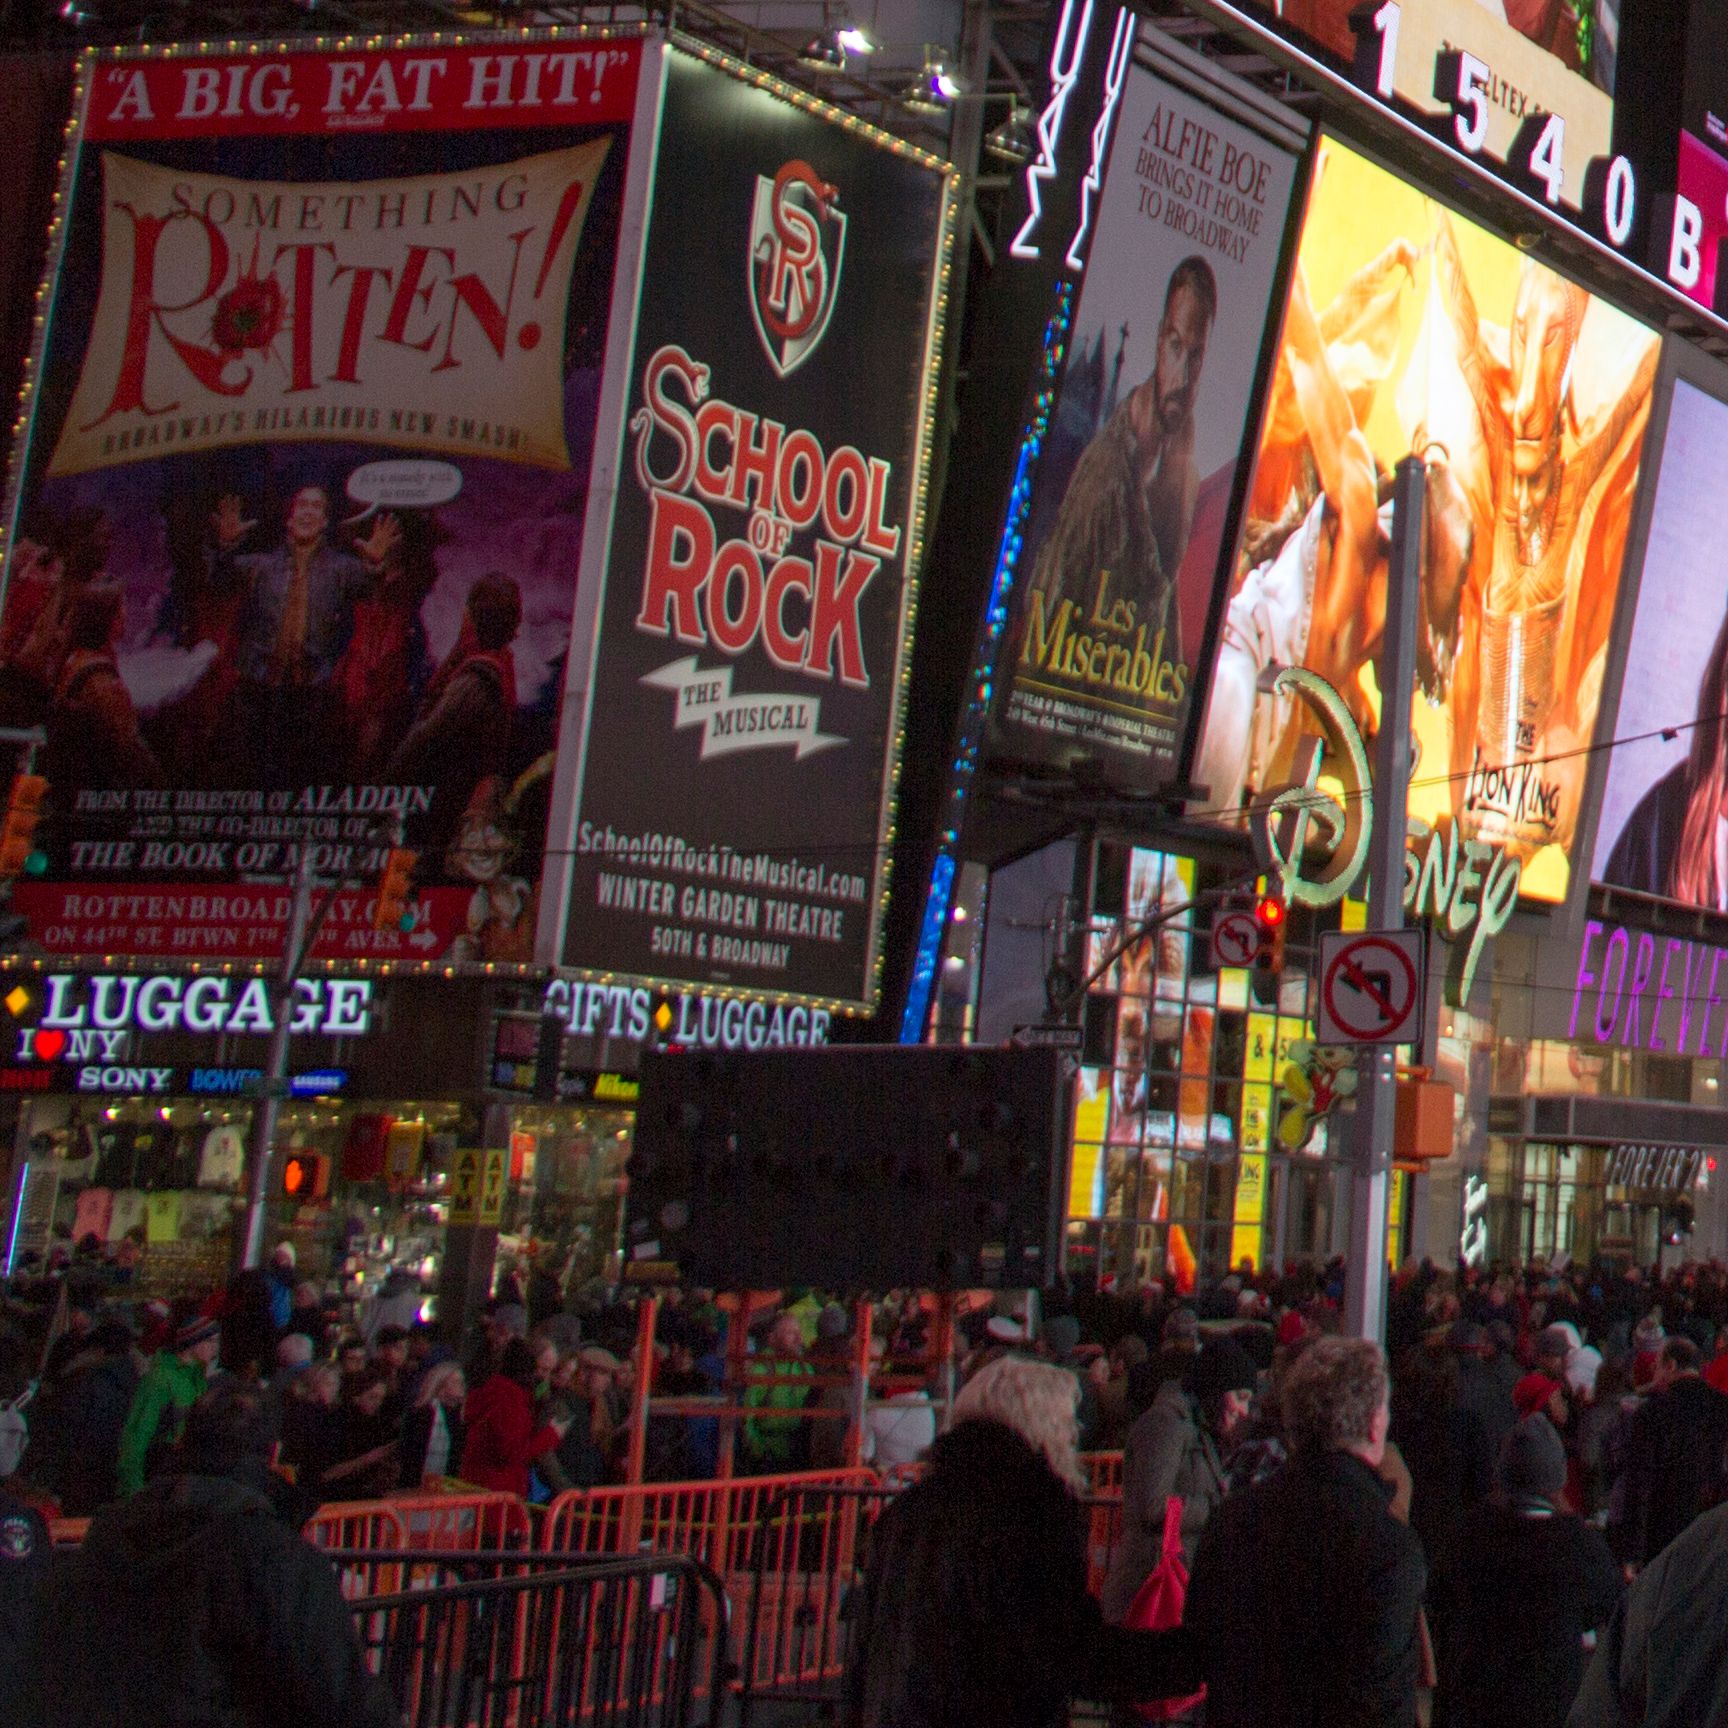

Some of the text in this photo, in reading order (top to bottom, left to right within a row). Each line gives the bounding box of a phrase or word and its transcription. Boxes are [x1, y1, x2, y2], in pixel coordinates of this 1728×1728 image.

[175, 65, 301, 121] BIG,
[321, 58, 447, 115] FAT
[1141, 101, 1273, 205] ALFIE BOE
[170, 173, 532, 235] SOMETHING
[1134, 147, 1261, 238] BRINGS IT HOME
[1136, 184, 1251, 266] TO BROADWAY
[384, 408, 437, 436] NEW
[629, 344, 901, 557] SCHOOL
[749, 512, 792, 559] OF
[635, 487, 882, 688] ROCK
[1089, 568, 1137, 637] Les
[1017, 586, 1191, 706] Misérables
[682, 680, 721, 707] THE
[711, 701, 809, 739] MUSICAL
[74, 784, 437, 814] FROM THE DIRECTOR ALADDIN
[1466, 742, 1561, 832] LION KING
[69, 840, 280, 872] THE BOOK OF
[171, 926, 240, 947] BTWN
[595, 870, 844, 943] WINTER GARDEN THEATRE
[650, 925, 791, 969] 50TH BROADWAY
[40, 973, 375, 1035] LUGGAGE
[544, 979, 652, 1039] GIFTS
[675, 993, 833, 1051] LUGGAGE
[77, 1066, 173, 1091] SONY
[593, 1075, 641, 1100] Nikon
[455, 1151, 478, 1215] ATM
[1608, 1143, 1684, 1189] FOREVER
